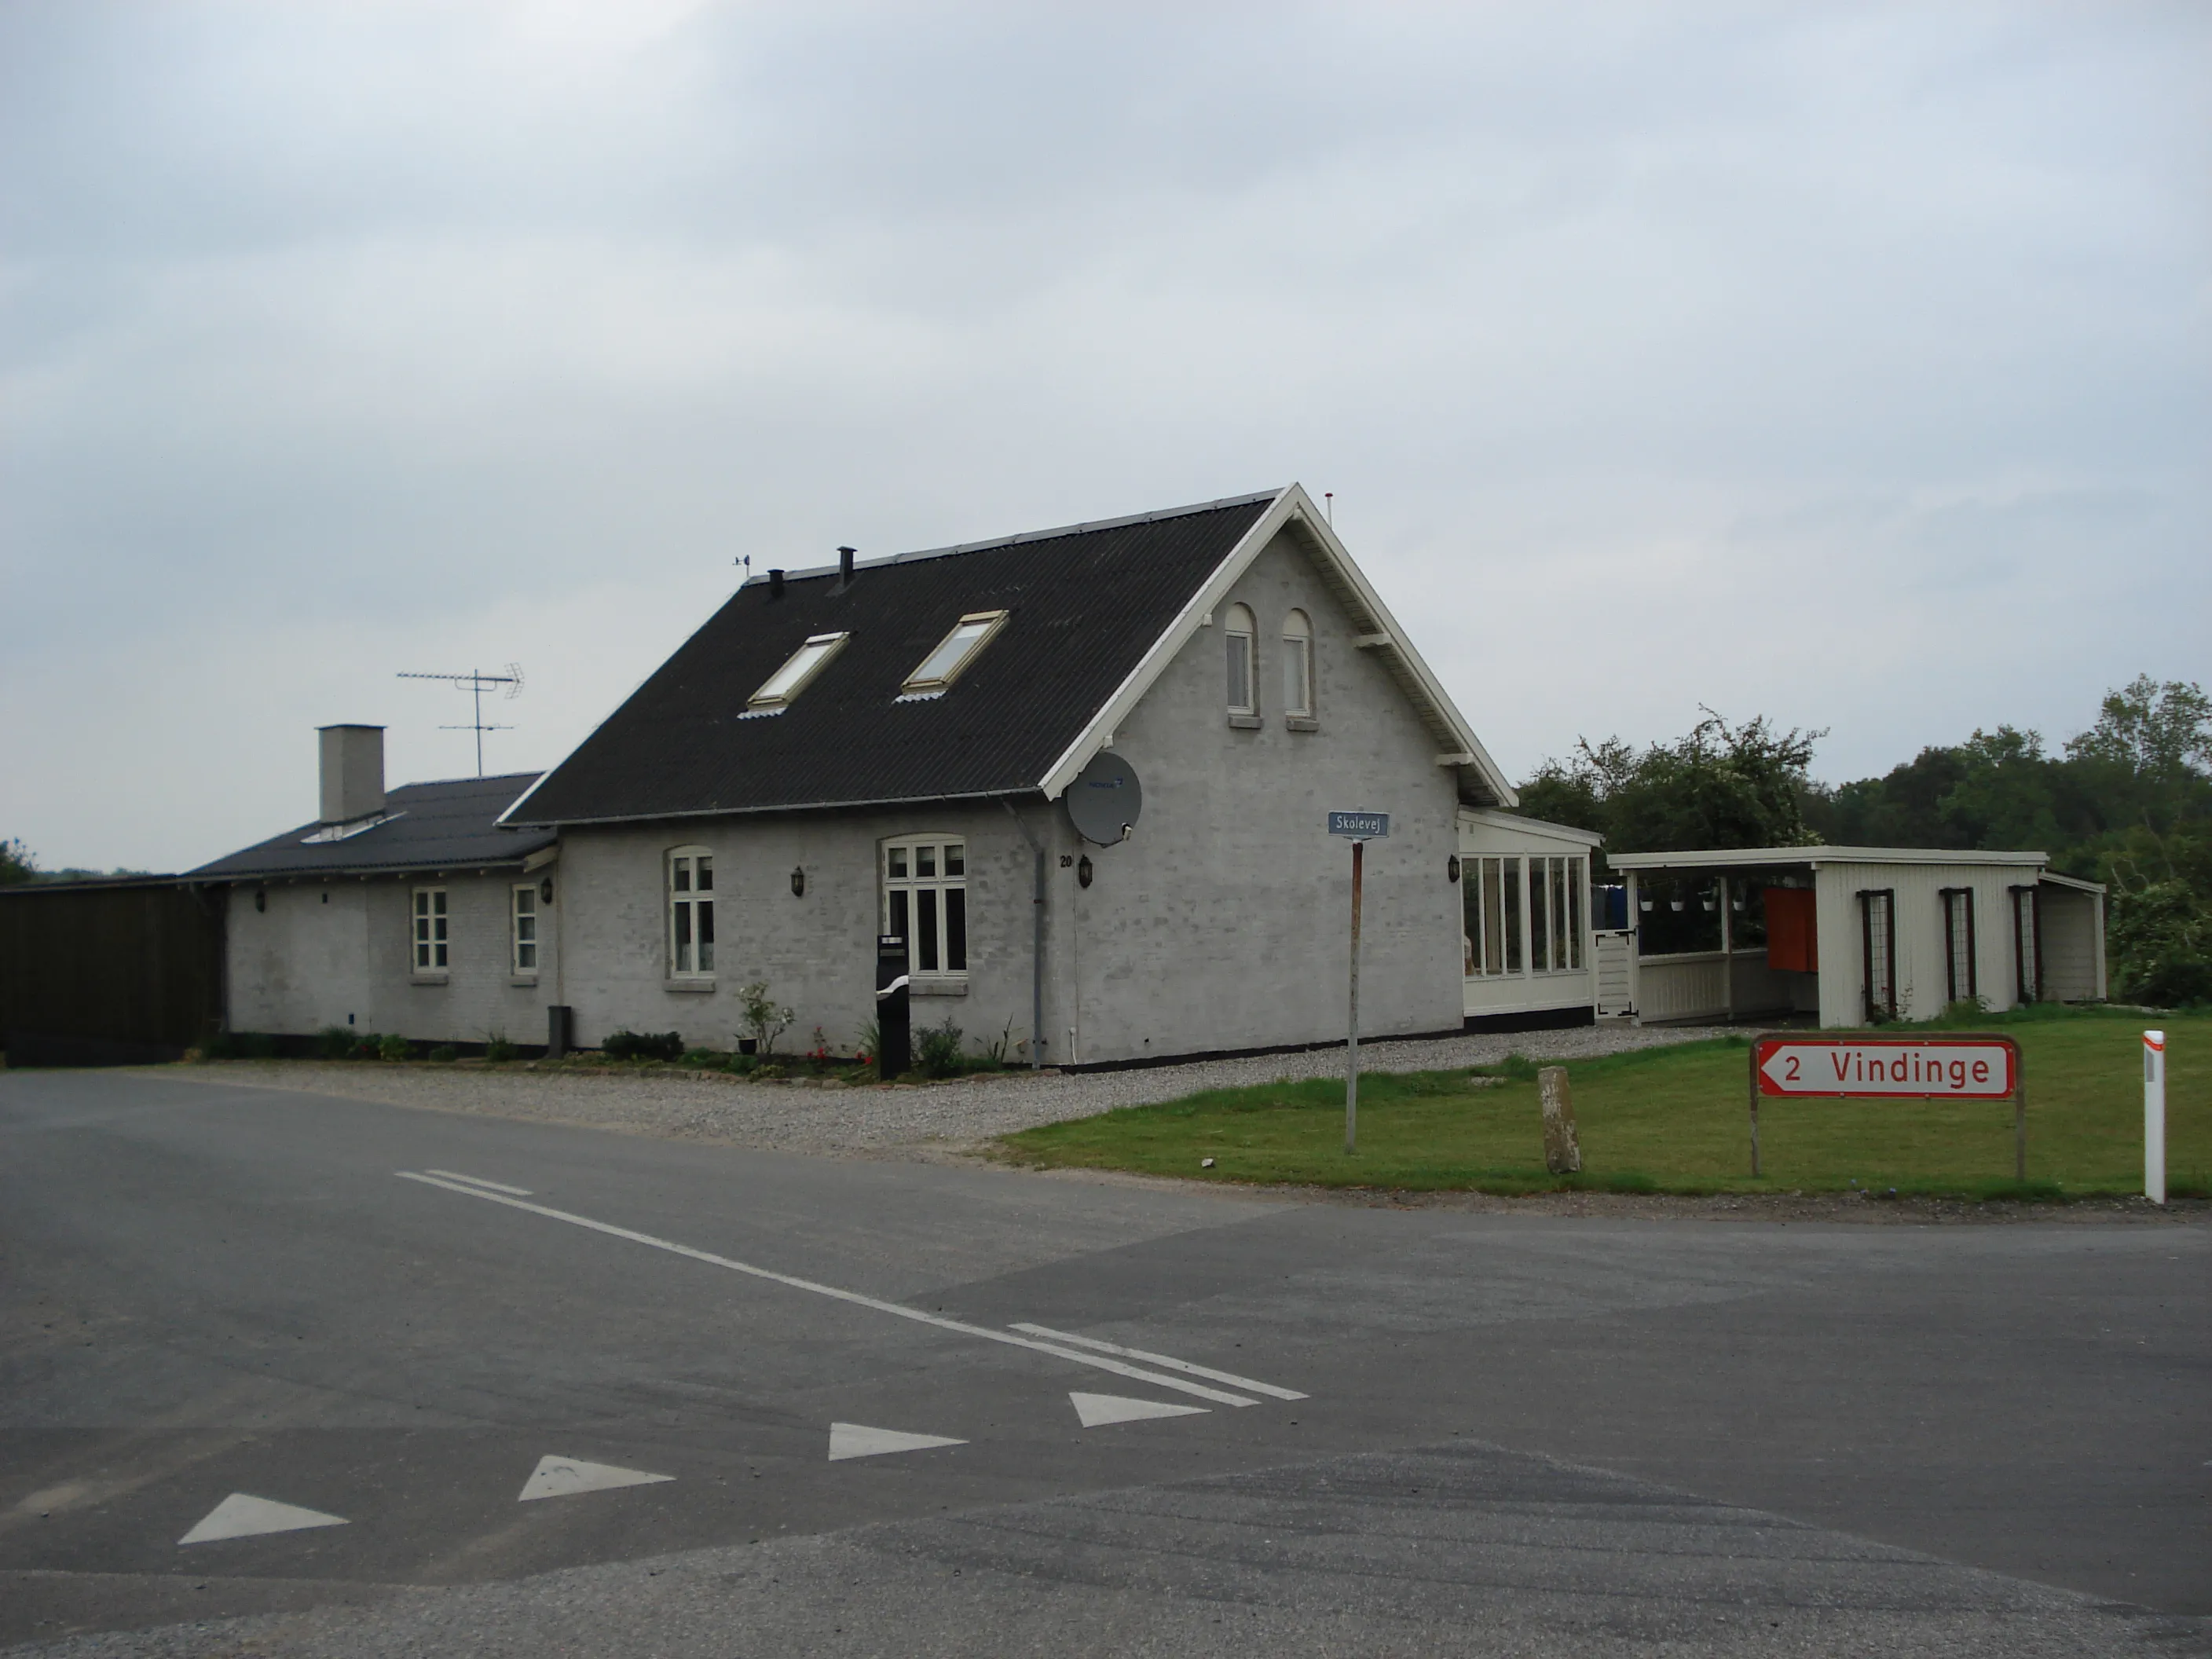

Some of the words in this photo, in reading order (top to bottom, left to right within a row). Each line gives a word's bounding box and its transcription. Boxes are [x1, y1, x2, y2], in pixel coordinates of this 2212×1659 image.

[1336, 815, 1380, 833] Skolevej
[1060, 855, 1072, 868] 20
[1785, 1056, 1800, 1081] 2
[1831, 1053, 1989, 1089] Vindinge
